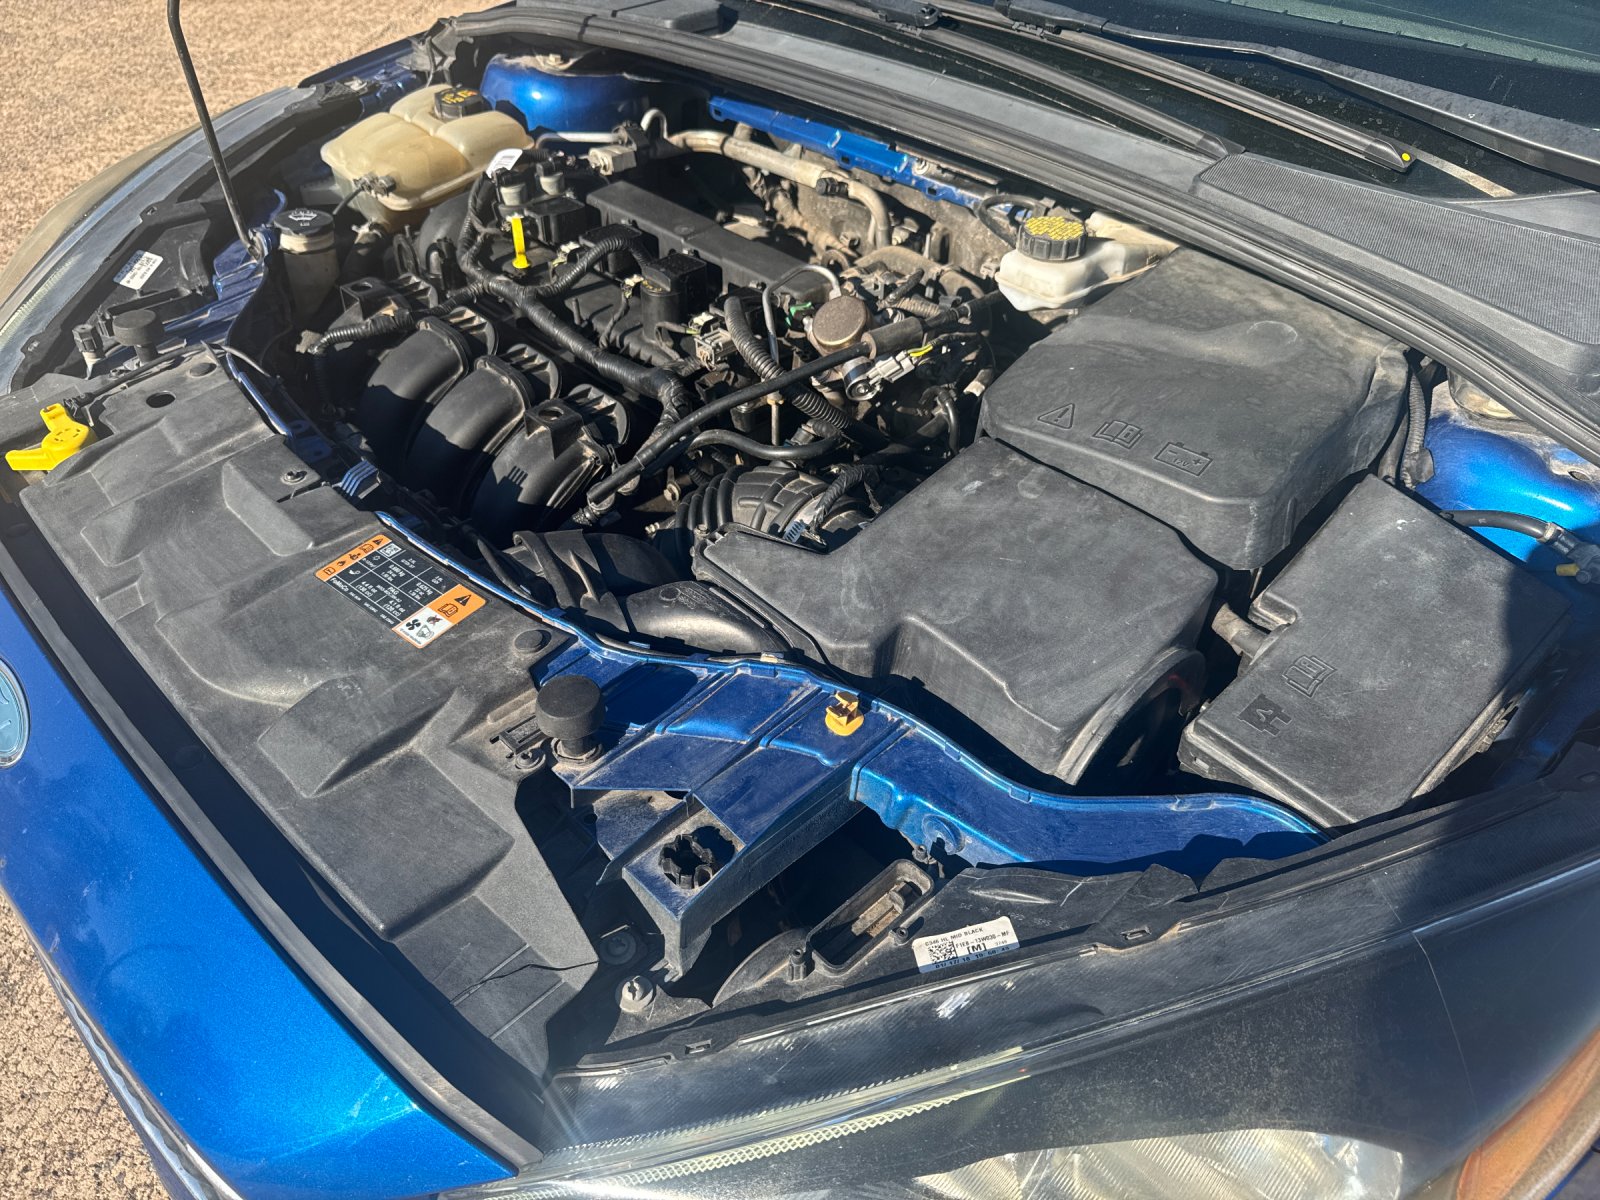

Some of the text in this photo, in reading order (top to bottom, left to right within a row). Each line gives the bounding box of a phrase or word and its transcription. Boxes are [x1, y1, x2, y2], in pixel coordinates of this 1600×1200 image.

[328, 576, 351, 592] FoMoCo
[386, 586, 400, 595] PAG
[963, 926, 983, 936] BLACK
[966, 942, 987, 954] [M]
